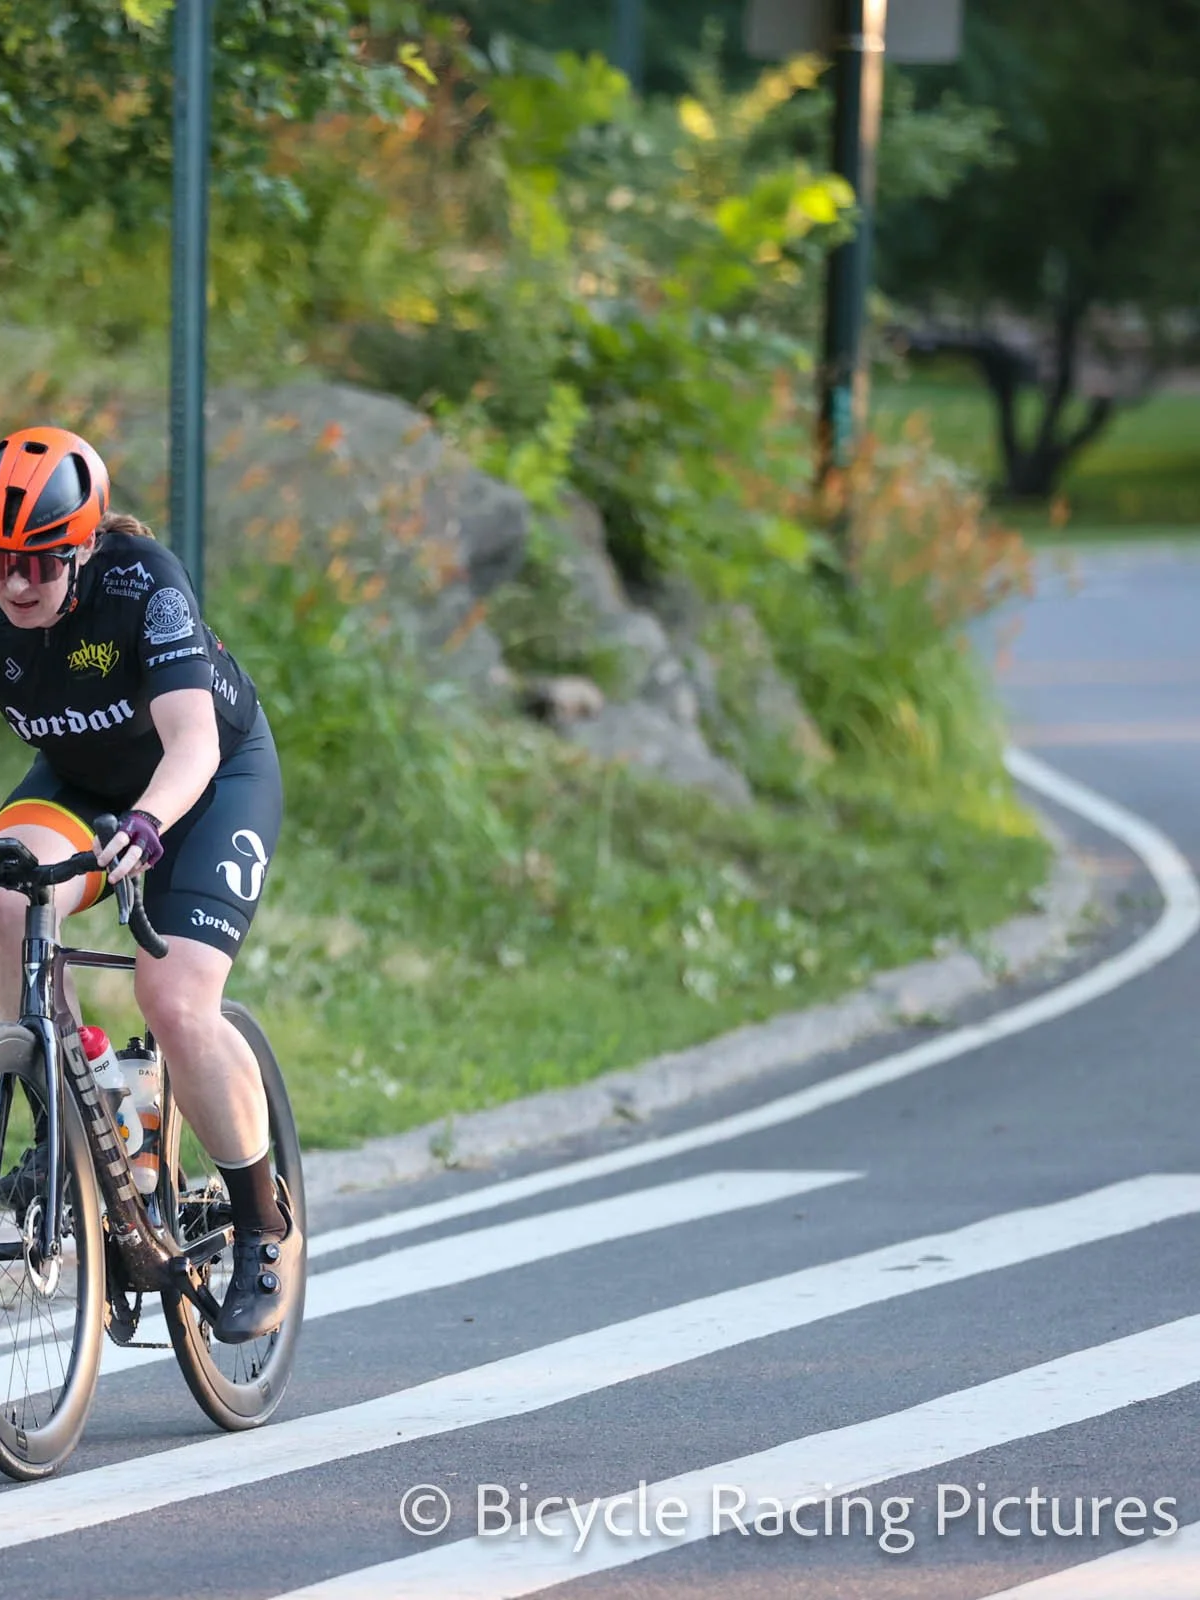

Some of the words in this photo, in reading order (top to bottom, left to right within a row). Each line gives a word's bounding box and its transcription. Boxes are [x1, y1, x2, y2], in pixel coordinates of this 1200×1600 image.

[145, 646, 205, 667] TREK
[5, 699, 135, 741] Jordan
[190, 908, 241, 942] Jordan
